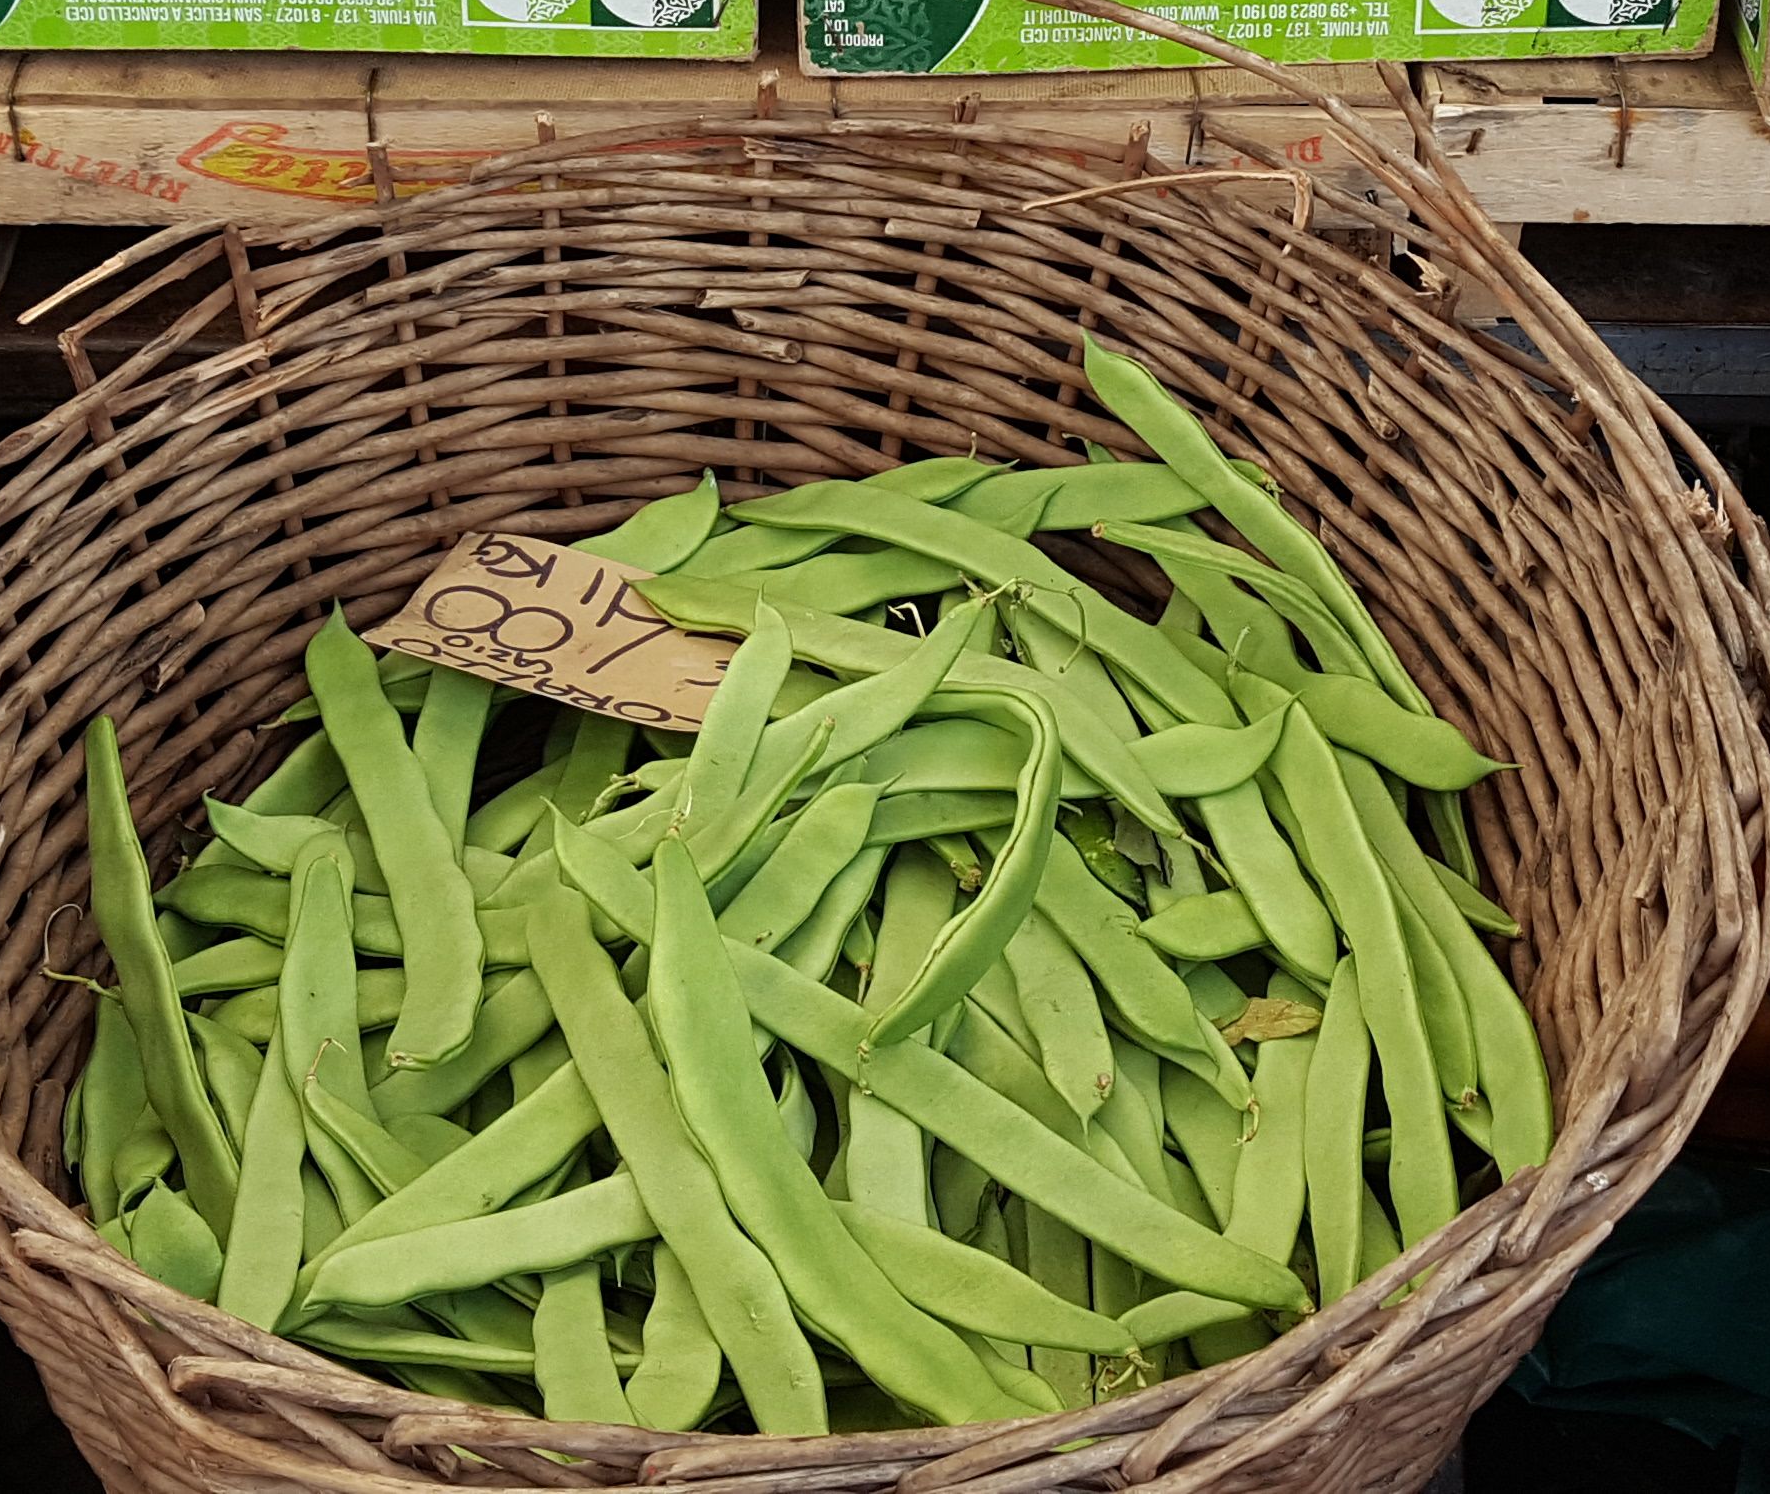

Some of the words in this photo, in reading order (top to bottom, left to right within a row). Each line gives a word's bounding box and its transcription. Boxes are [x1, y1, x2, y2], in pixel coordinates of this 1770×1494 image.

[98, 5, 170, 22] CANCELLO
[171, 6, 182, 22] A
[183, 6, 232, 22] FELICE
[234, 6, 263, 23] SAN
[333, 8, 359, 24] 137
[414, 9, 437, 25] VIA
[1289, 3, 1328, 19] 0823
[1330, 2, 1358, 19] +39
[1051, 26, 1122, 43] CANCELLO
[1286, 21, 1312, 38] 137
[1366, 21, 1390, 37] VIA
[468, 533, 559, 589] KG
[390, 637, 703, 726] ORALLO
